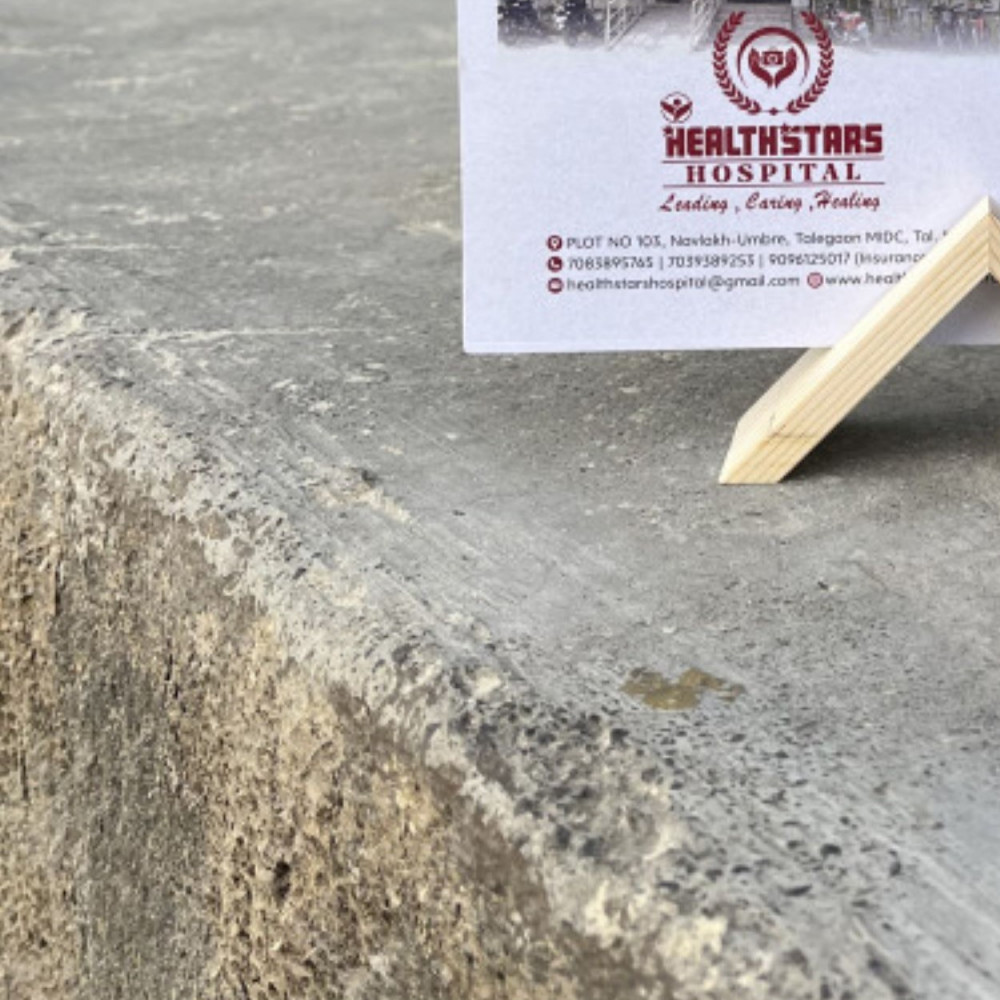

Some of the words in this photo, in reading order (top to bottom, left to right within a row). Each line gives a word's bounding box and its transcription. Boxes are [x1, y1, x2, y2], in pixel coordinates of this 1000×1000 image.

[686, 162, 862, 184] HOSPITAL
[658, 192, 729, 214] Leading
[744, 191, 803, 214] Caring
[566, 235, 604, 250] PLOT
[608, 234, 632, 249] NO
[794, 231, 862, 248] Talegaon
[864, 230, 910, 246] MIDC,
